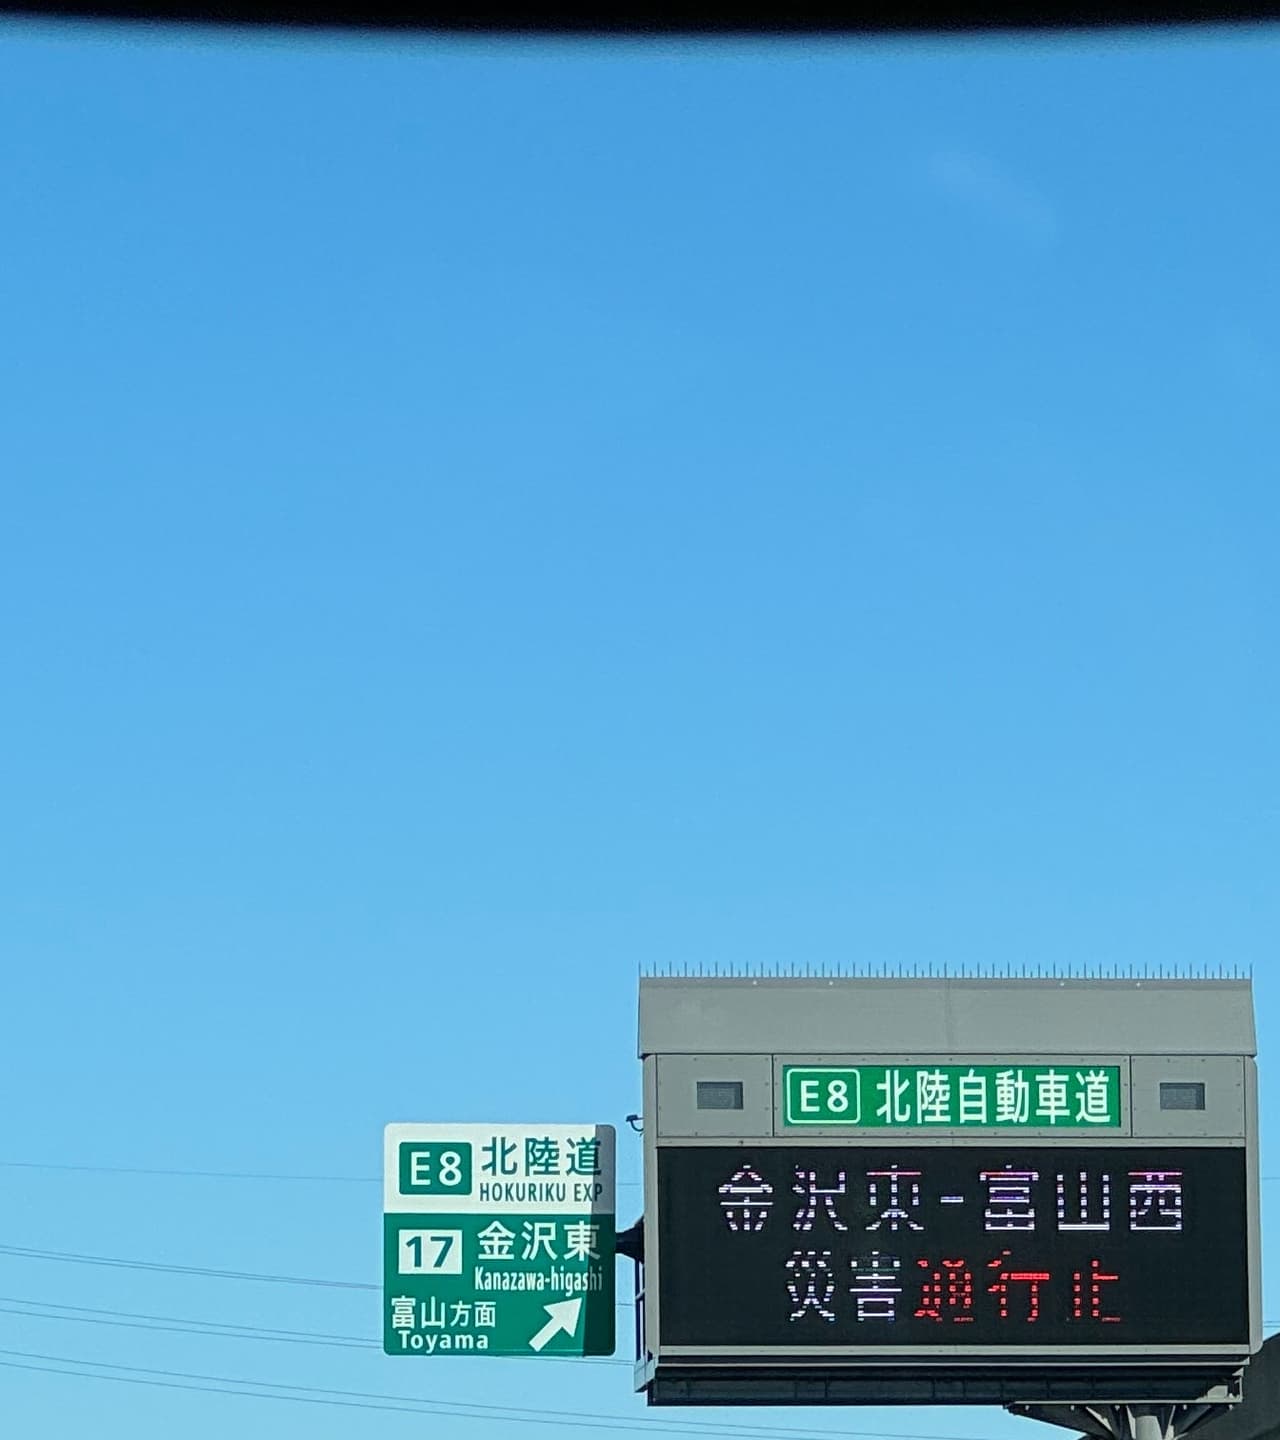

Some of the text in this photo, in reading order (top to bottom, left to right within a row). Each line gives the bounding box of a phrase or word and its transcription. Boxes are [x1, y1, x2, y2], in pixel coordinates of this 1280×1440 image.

[800, 1079, 850, 1113] E8
[875, 1069, 1111, 1125] 北陸自動車道
[410, 1151, 463, 1187] E8
[481, 1136, 602, 1178] 北陸道
[479, 1182, 603, 1202] HOKURIKU EXP
[405, 1235, 454, 1269] 17
[476, 1220, 601, 1262] 金沢東
[474, 1265, 603, 1297] Kanazawa-higashi
[390, 1295, 497, 1330] 富山方面
[397, 1329, 489, 1354] Toyama
